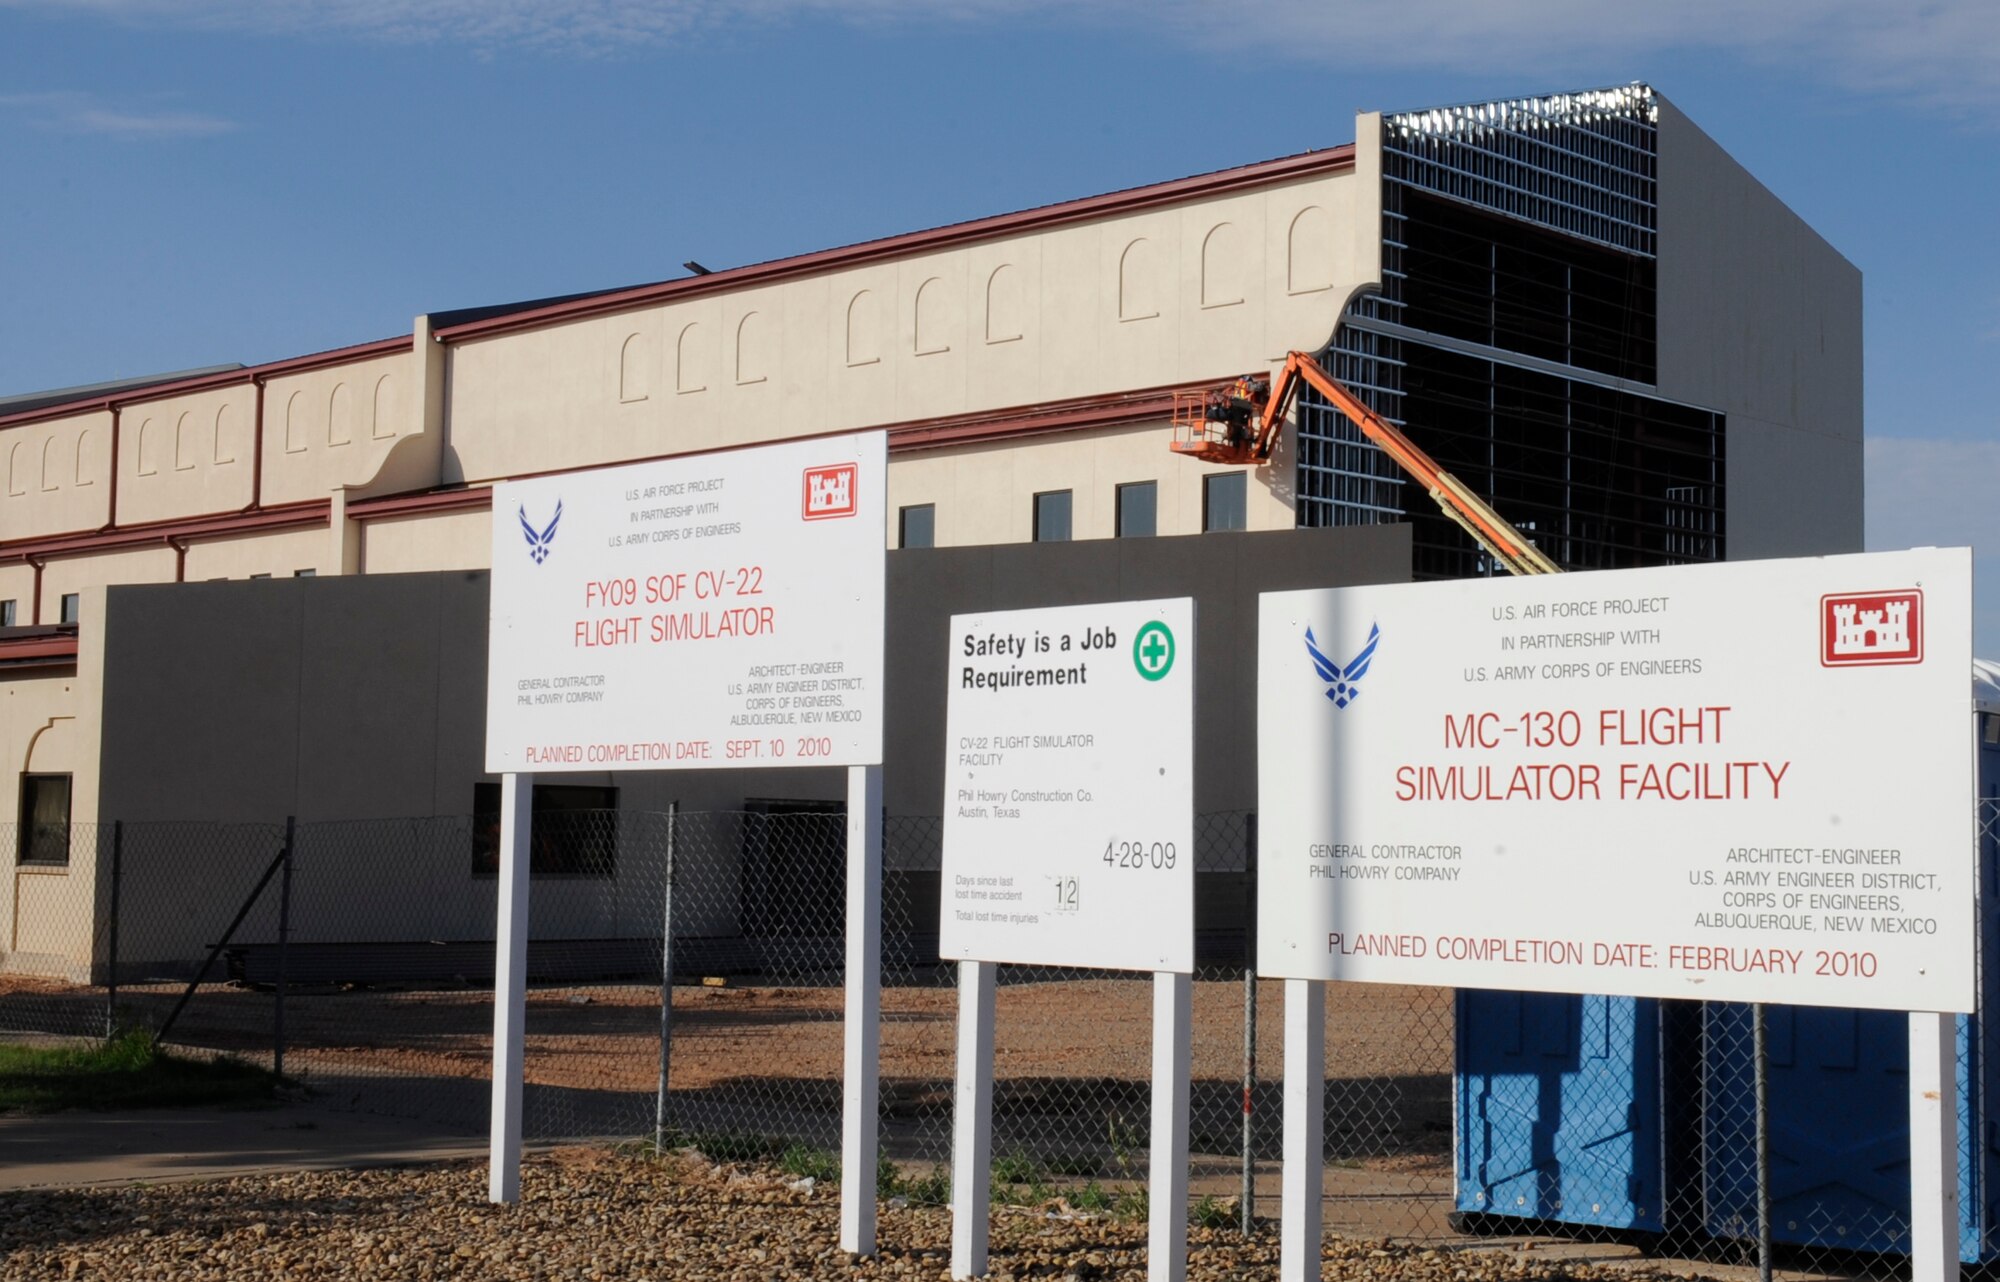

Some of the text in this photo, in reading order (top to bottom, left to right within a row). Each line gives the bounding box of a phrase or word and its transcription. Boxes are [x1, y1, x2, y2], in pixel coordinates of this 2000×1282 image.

[626, 478, 725, 501] U.S. AIR FORCE PROJECT
[630, 502, 719, 522] IN PARTNERSHIP WITH
[609, 522, 741, 547] U.S. ARMY CORPS OF ENGINEERS
[587, 566, 763, 608] FY09 SOF CV-22
[1493, 597, 1669, 621] U.S. AIR FORCE PROJECT
[575, 606, 774, 647] FLIGHT SIMULATOR
[964, 626, 1116, 659] Safety is a Job
[1501, 629, 1660, 650] IN PARTNERSHIP WITH
[748, 661, 844, 677] ARCHITECT-ENGINEER
[963, 663, 1086, 692] Requirement
[1464, 658, 1702, 682] U.S. ARMY CORPS OF ENGINEERS
[518, 675, 605, 690] GENERAL CONTRACTOR
[728, 678, 864, 695] U.S. ARMY ENGINEER DISTRICT,
[518, 691, 604, 705] PHIL HOWRY COMPANY
[746, 694, 844, 710] CORPS OF ENGINEERS,
[730, 710, 862, 726] ALBUQUERQUE, NEW MEXICO
[1445, 707, 1731, 749] MC-130 FLIGHT
[526, 737, 831, 763] PLANNED COMPLETION DATE: SEPT. 10 2010
[960, 734, 1094, 750] CV-22 FLIGHT SIMULATOR
[959, 753, 1003, 766] FACILITY
[1396, 762, 1790, 801] SIMULATOR FACILITY
[958, 789, 1093, 804] Phil Howry Construction Co.
[958, 806, 1020, 818] Austin, Texas
[1103, 842, 1176, 869] 4-28-09
[1309, 844, 1461, 860] GENERAL CONTRACTOR
[1726, 848, 1901, 865] ARCHITECT-ENGINEER
[956, 875, 1013, 887] Days since last
[1310, 865, 1461, 881] PHIL HOWRY COMPANY
[1689, 870, 1941, 892] U.S. ARMY ENGINEER DISTRICT,
[955, 889, 1022, 900] lost time accident
[1723, 891, 1904, 913] CORPS OF ENGINEERS,
[955, 910, 1039, 925] Total lost time injuries
[1695, 912, 1937, 934] ALBUQUERQUE, NEW MEXICO
[1329, 933, 1877, 977] PLANNED COMPLETION DATE: FEBRUARY 2010
